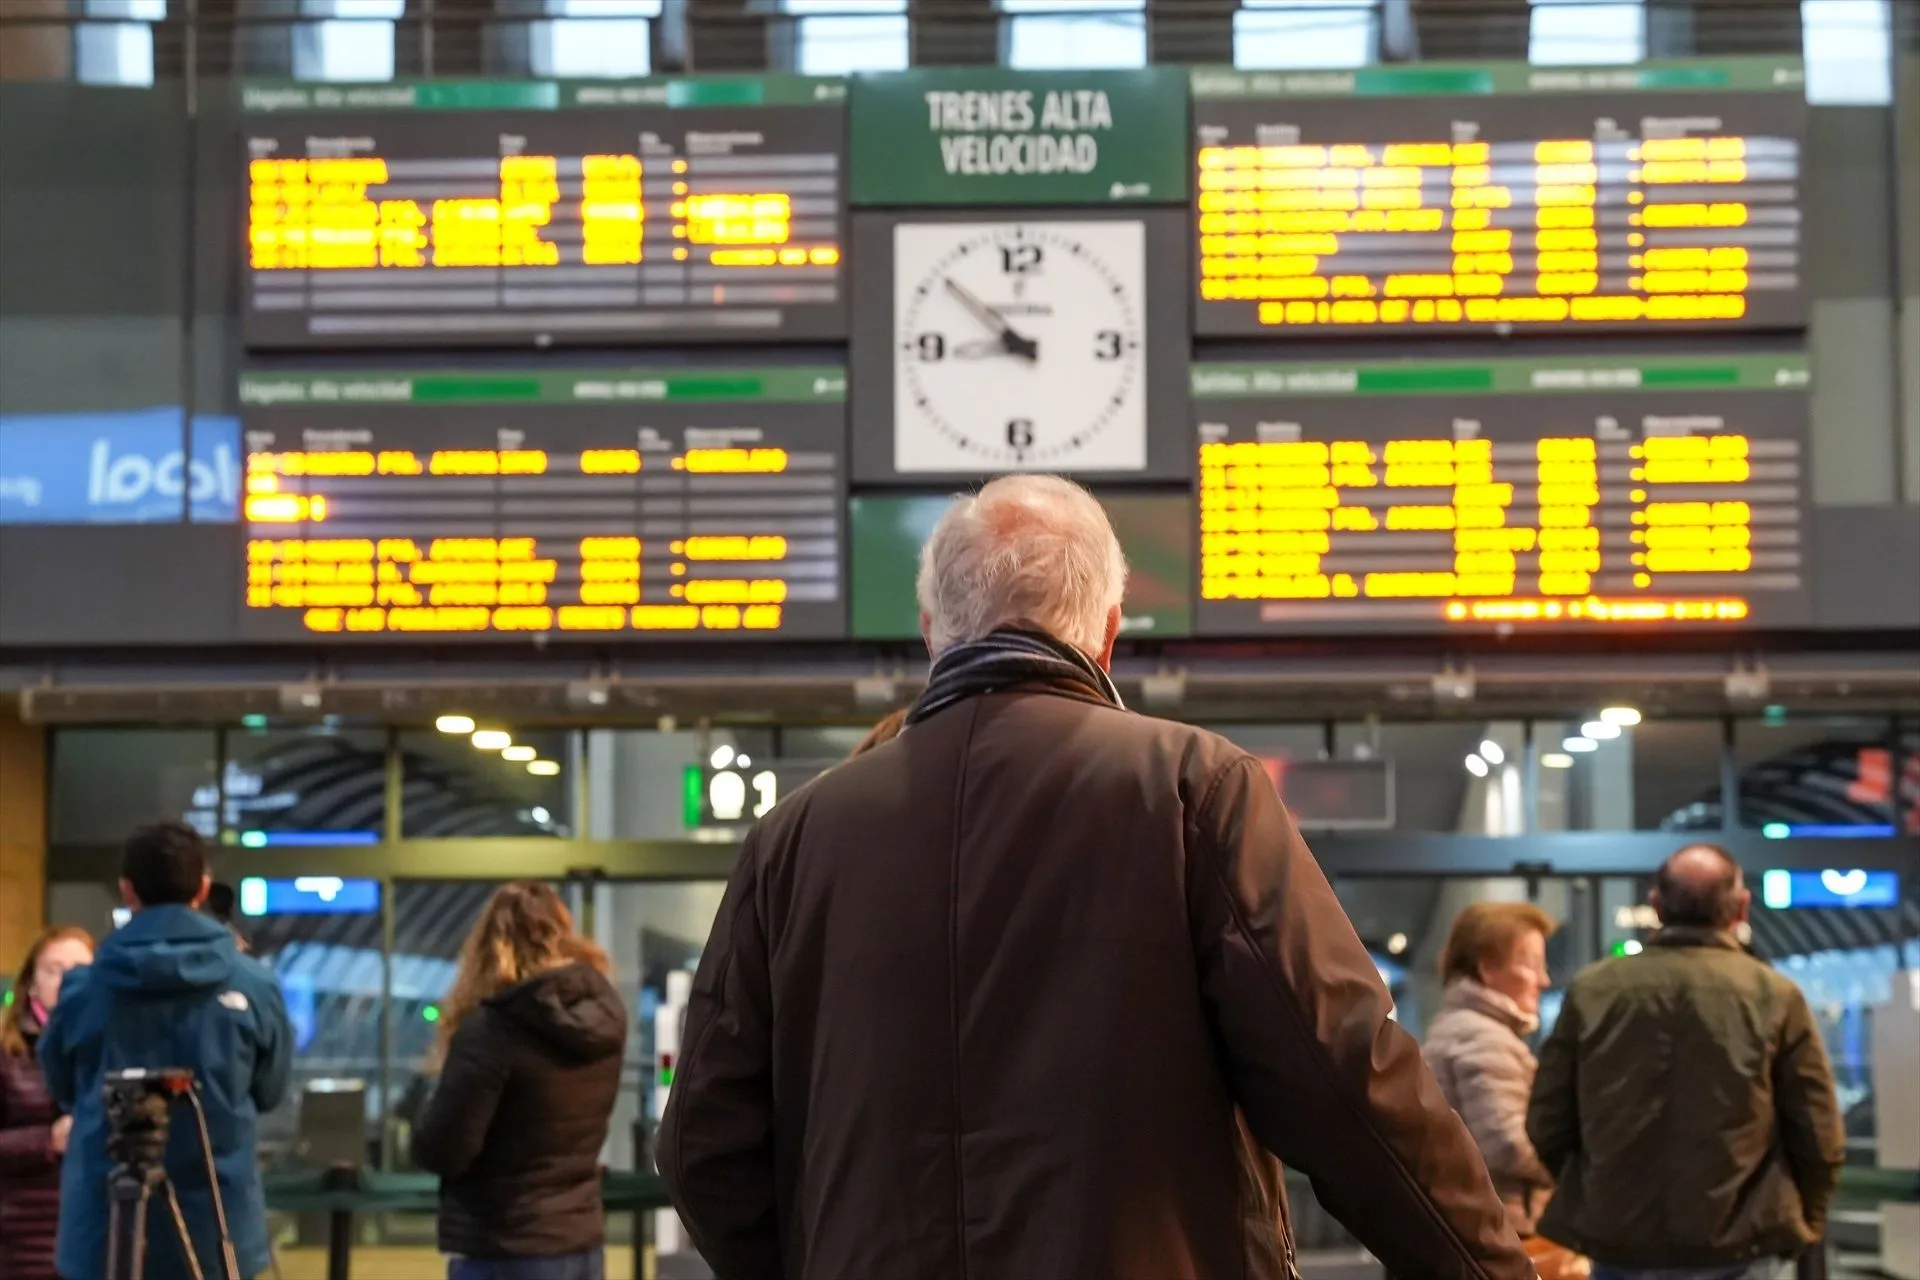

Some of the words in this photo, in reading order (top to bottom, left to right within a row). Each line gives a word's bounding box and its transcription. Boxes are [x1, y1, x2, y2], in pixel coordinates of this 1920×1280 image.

[925, 91, 1034, 131] TRENES
[1041, 90, 1112, 130] ALTA
[941, 134, 1097, 174] VELOCIDAD
[1001, 245, 1043, 274] 12
[918, 332, 945, 362] 9
[1093, 330, 1122, 361] 3
[1006, 418, 1034, 449] 6
